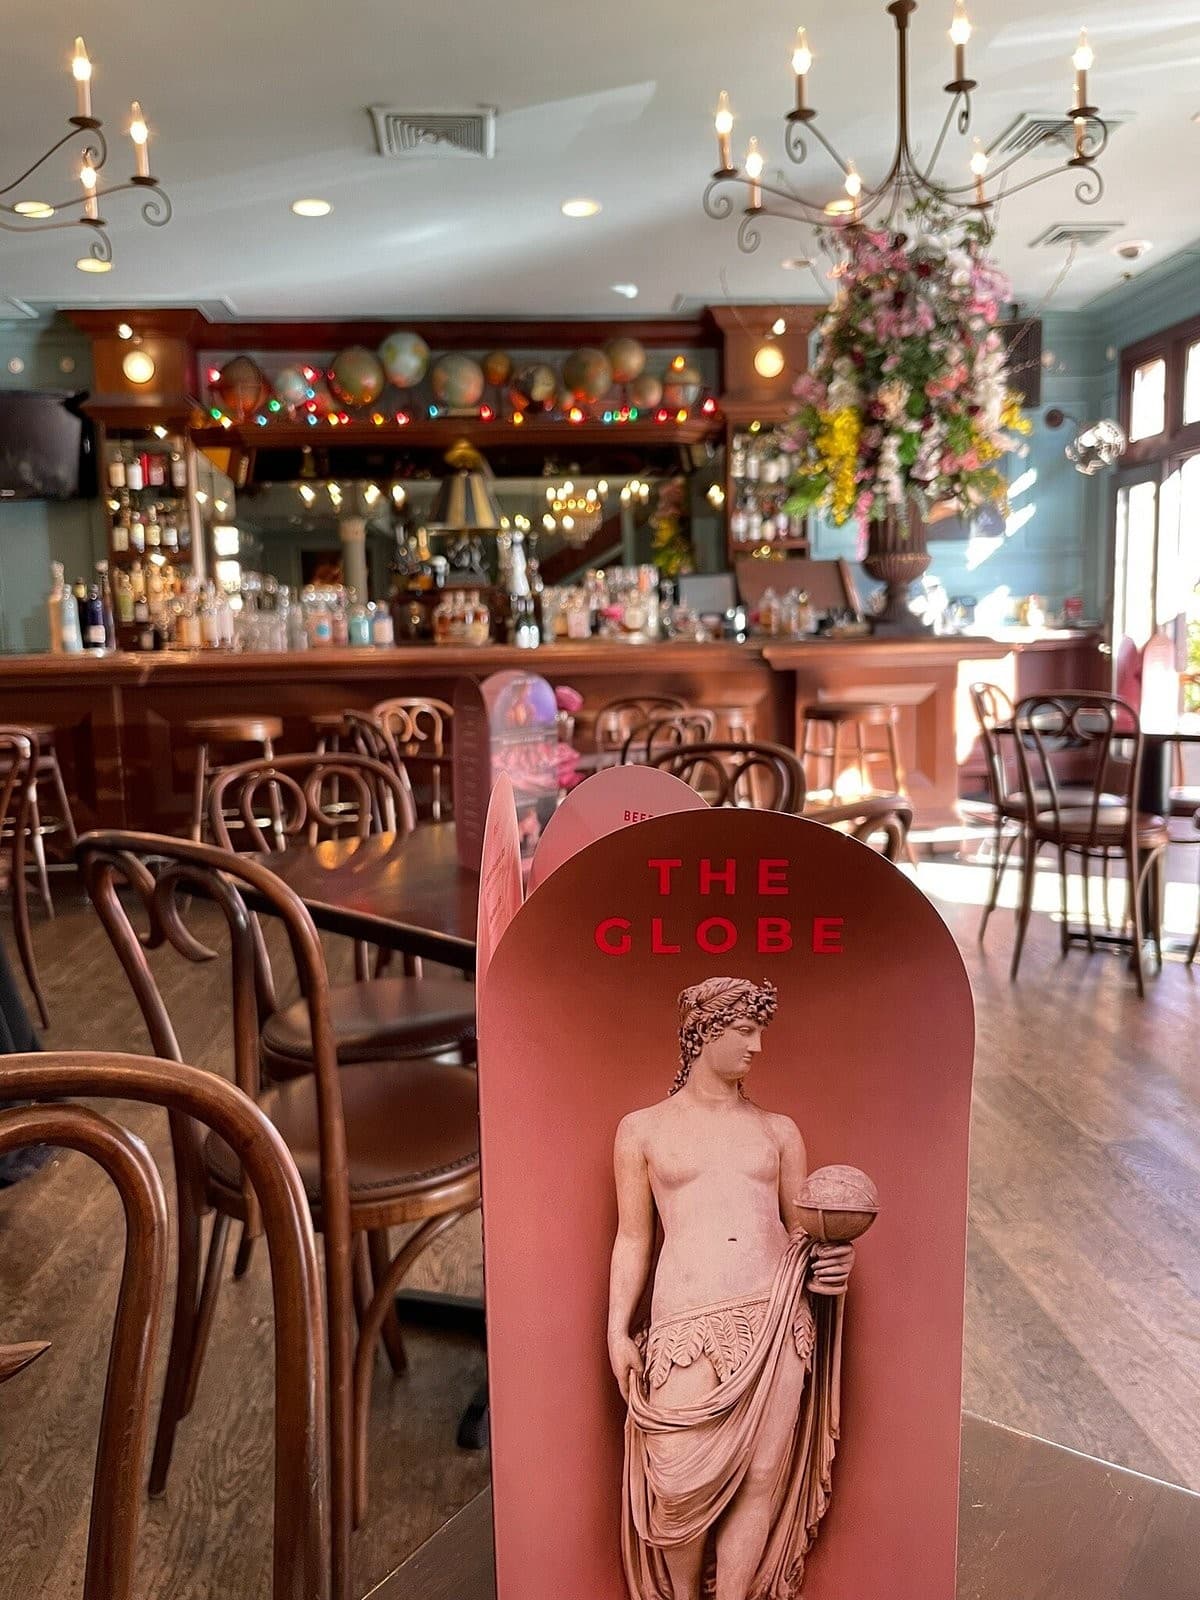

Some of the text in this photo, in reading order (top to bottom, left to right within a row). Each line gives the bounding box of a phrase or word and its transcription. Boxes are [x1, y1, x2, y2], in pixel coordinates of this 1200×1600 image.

[624, 810, 654, 822] BEE
[648, 859, 790, 896] THE
[594, 916, 845, 956] GLOBE
